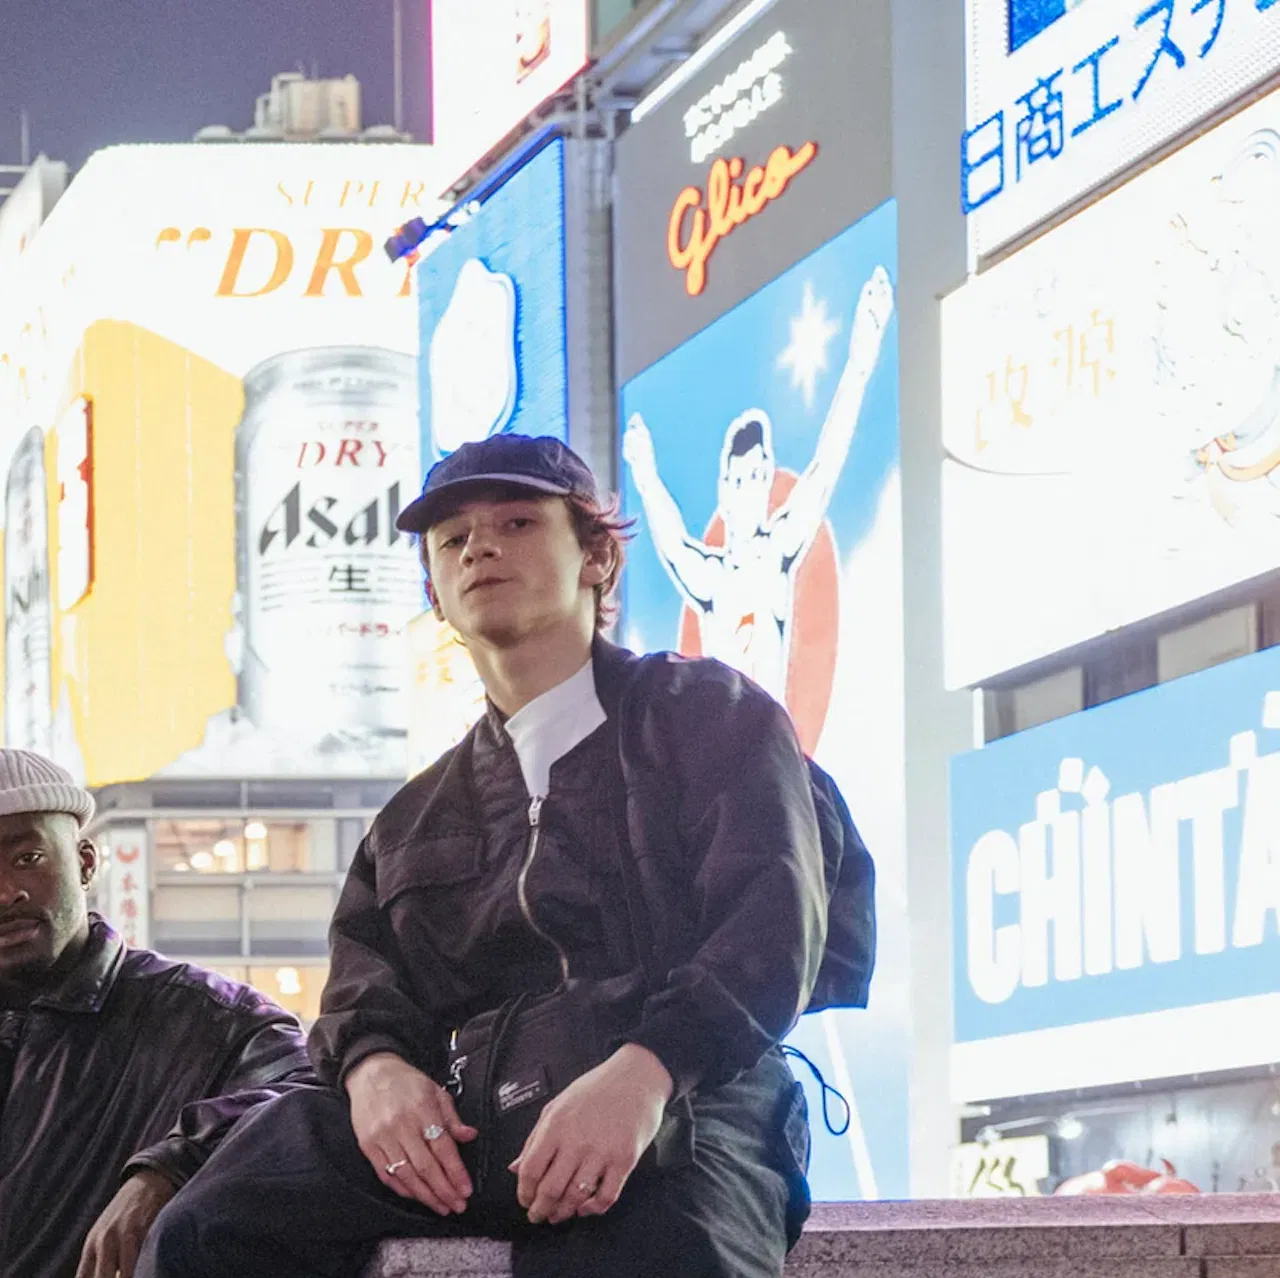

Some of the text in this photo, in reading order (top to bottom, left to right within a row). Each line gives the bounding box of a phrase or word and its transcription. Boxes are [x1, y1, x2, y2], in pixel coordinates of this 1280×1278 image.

[668, 141, 816, 297] Glico
[296, 438, 391, 470] DRY
[328, 562, 371, 593] 生
